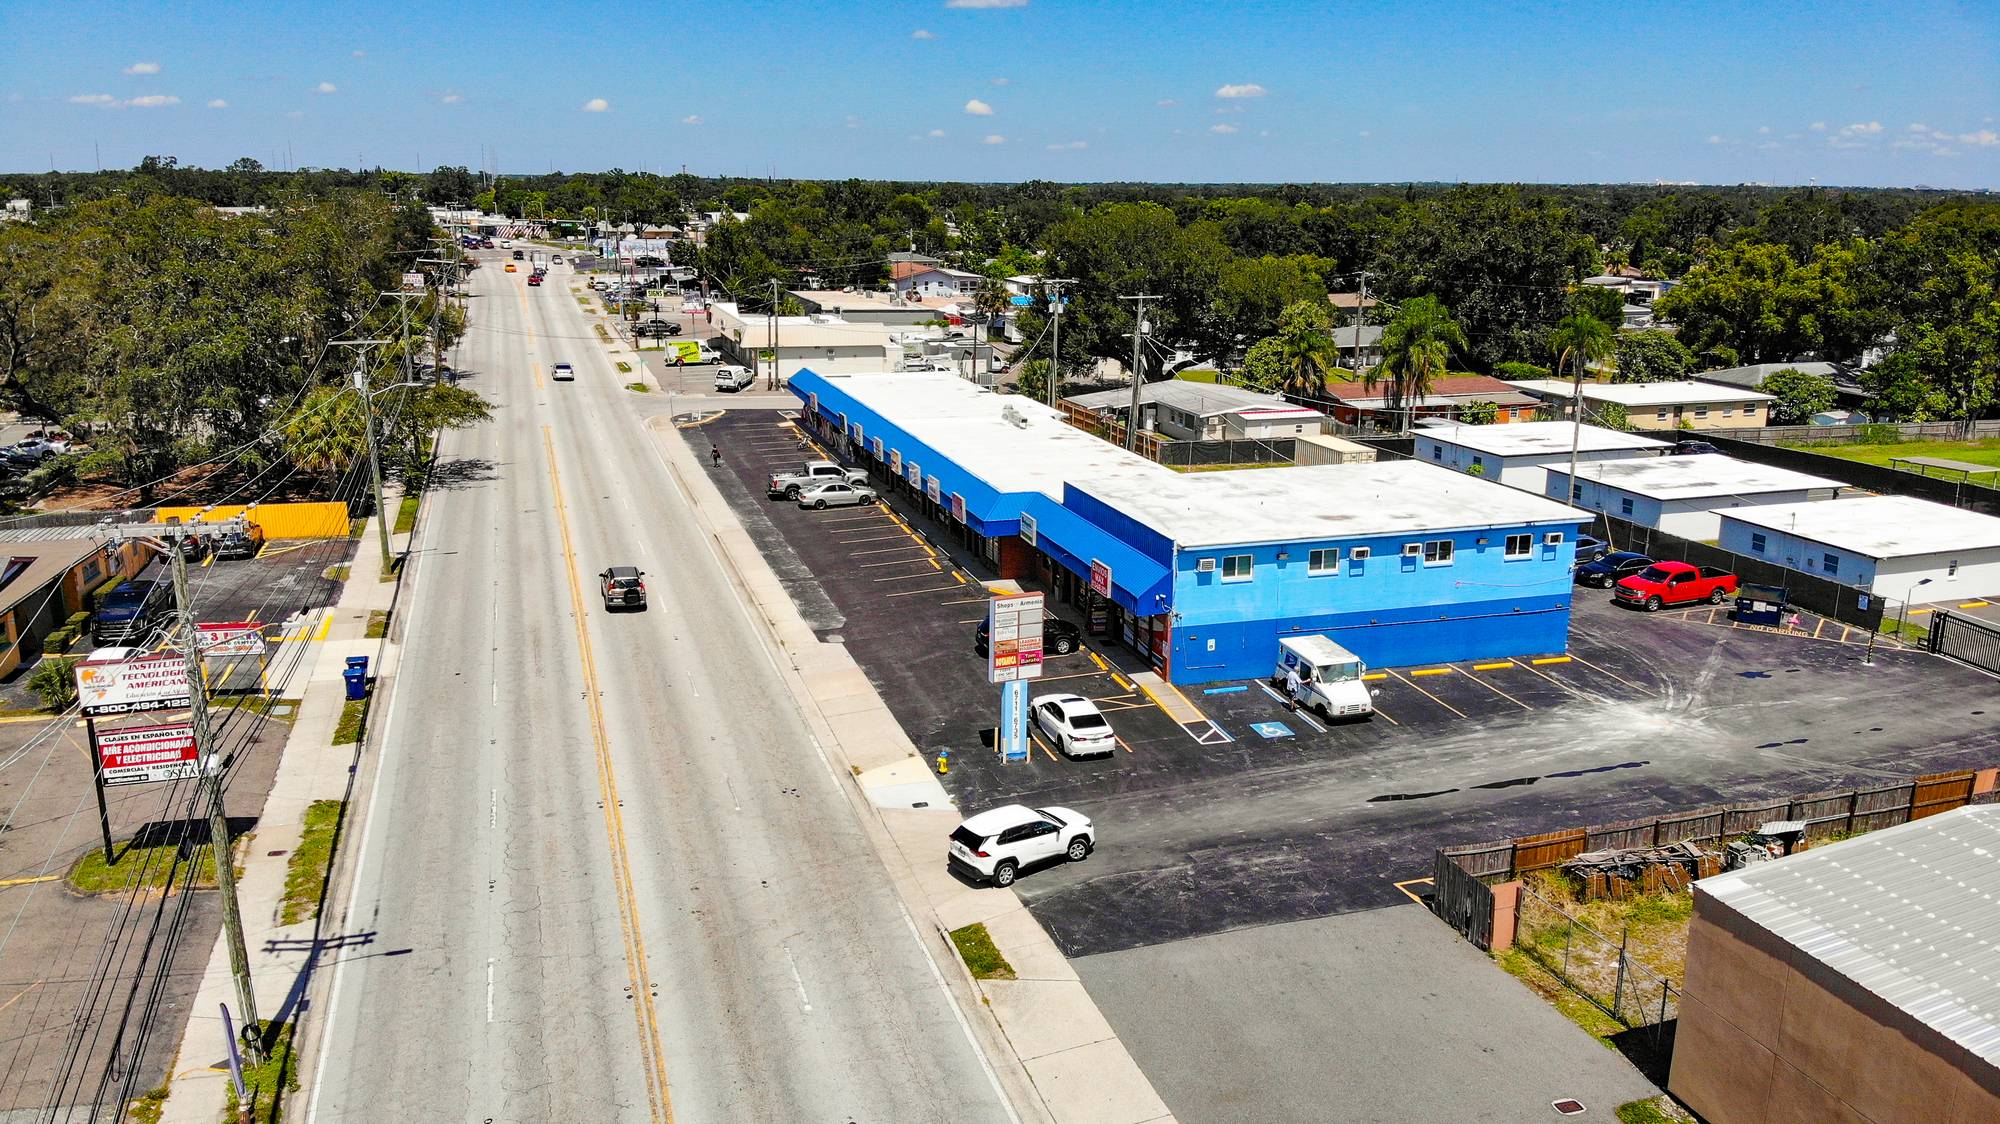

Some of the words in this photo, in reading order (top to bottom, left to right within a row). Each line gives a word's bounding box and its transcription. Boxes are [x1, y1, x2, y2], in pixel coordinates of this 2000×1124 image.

[1019, 598, 1043, 606] Armenia
[1766, 627, 1809, 637] PARKING
[128, 660, 185, 671] INSTITUTO
[86, 699, 190, 715] 1-800-494-122
[104, 735, 129, 743] CLASES
[142, 731, 174, 740] ESPAÑOL
[103, 745, 123, 756] AIRE
[115, 756, 122, 765] Y
[123, 750, 182, 763] ELECTRICIDAD
[109, 767, 144, 775] COMERCIAL
[152, 762, 192, 770] RESIDENCIAL
[164, 767, 196, 778] OSHA
